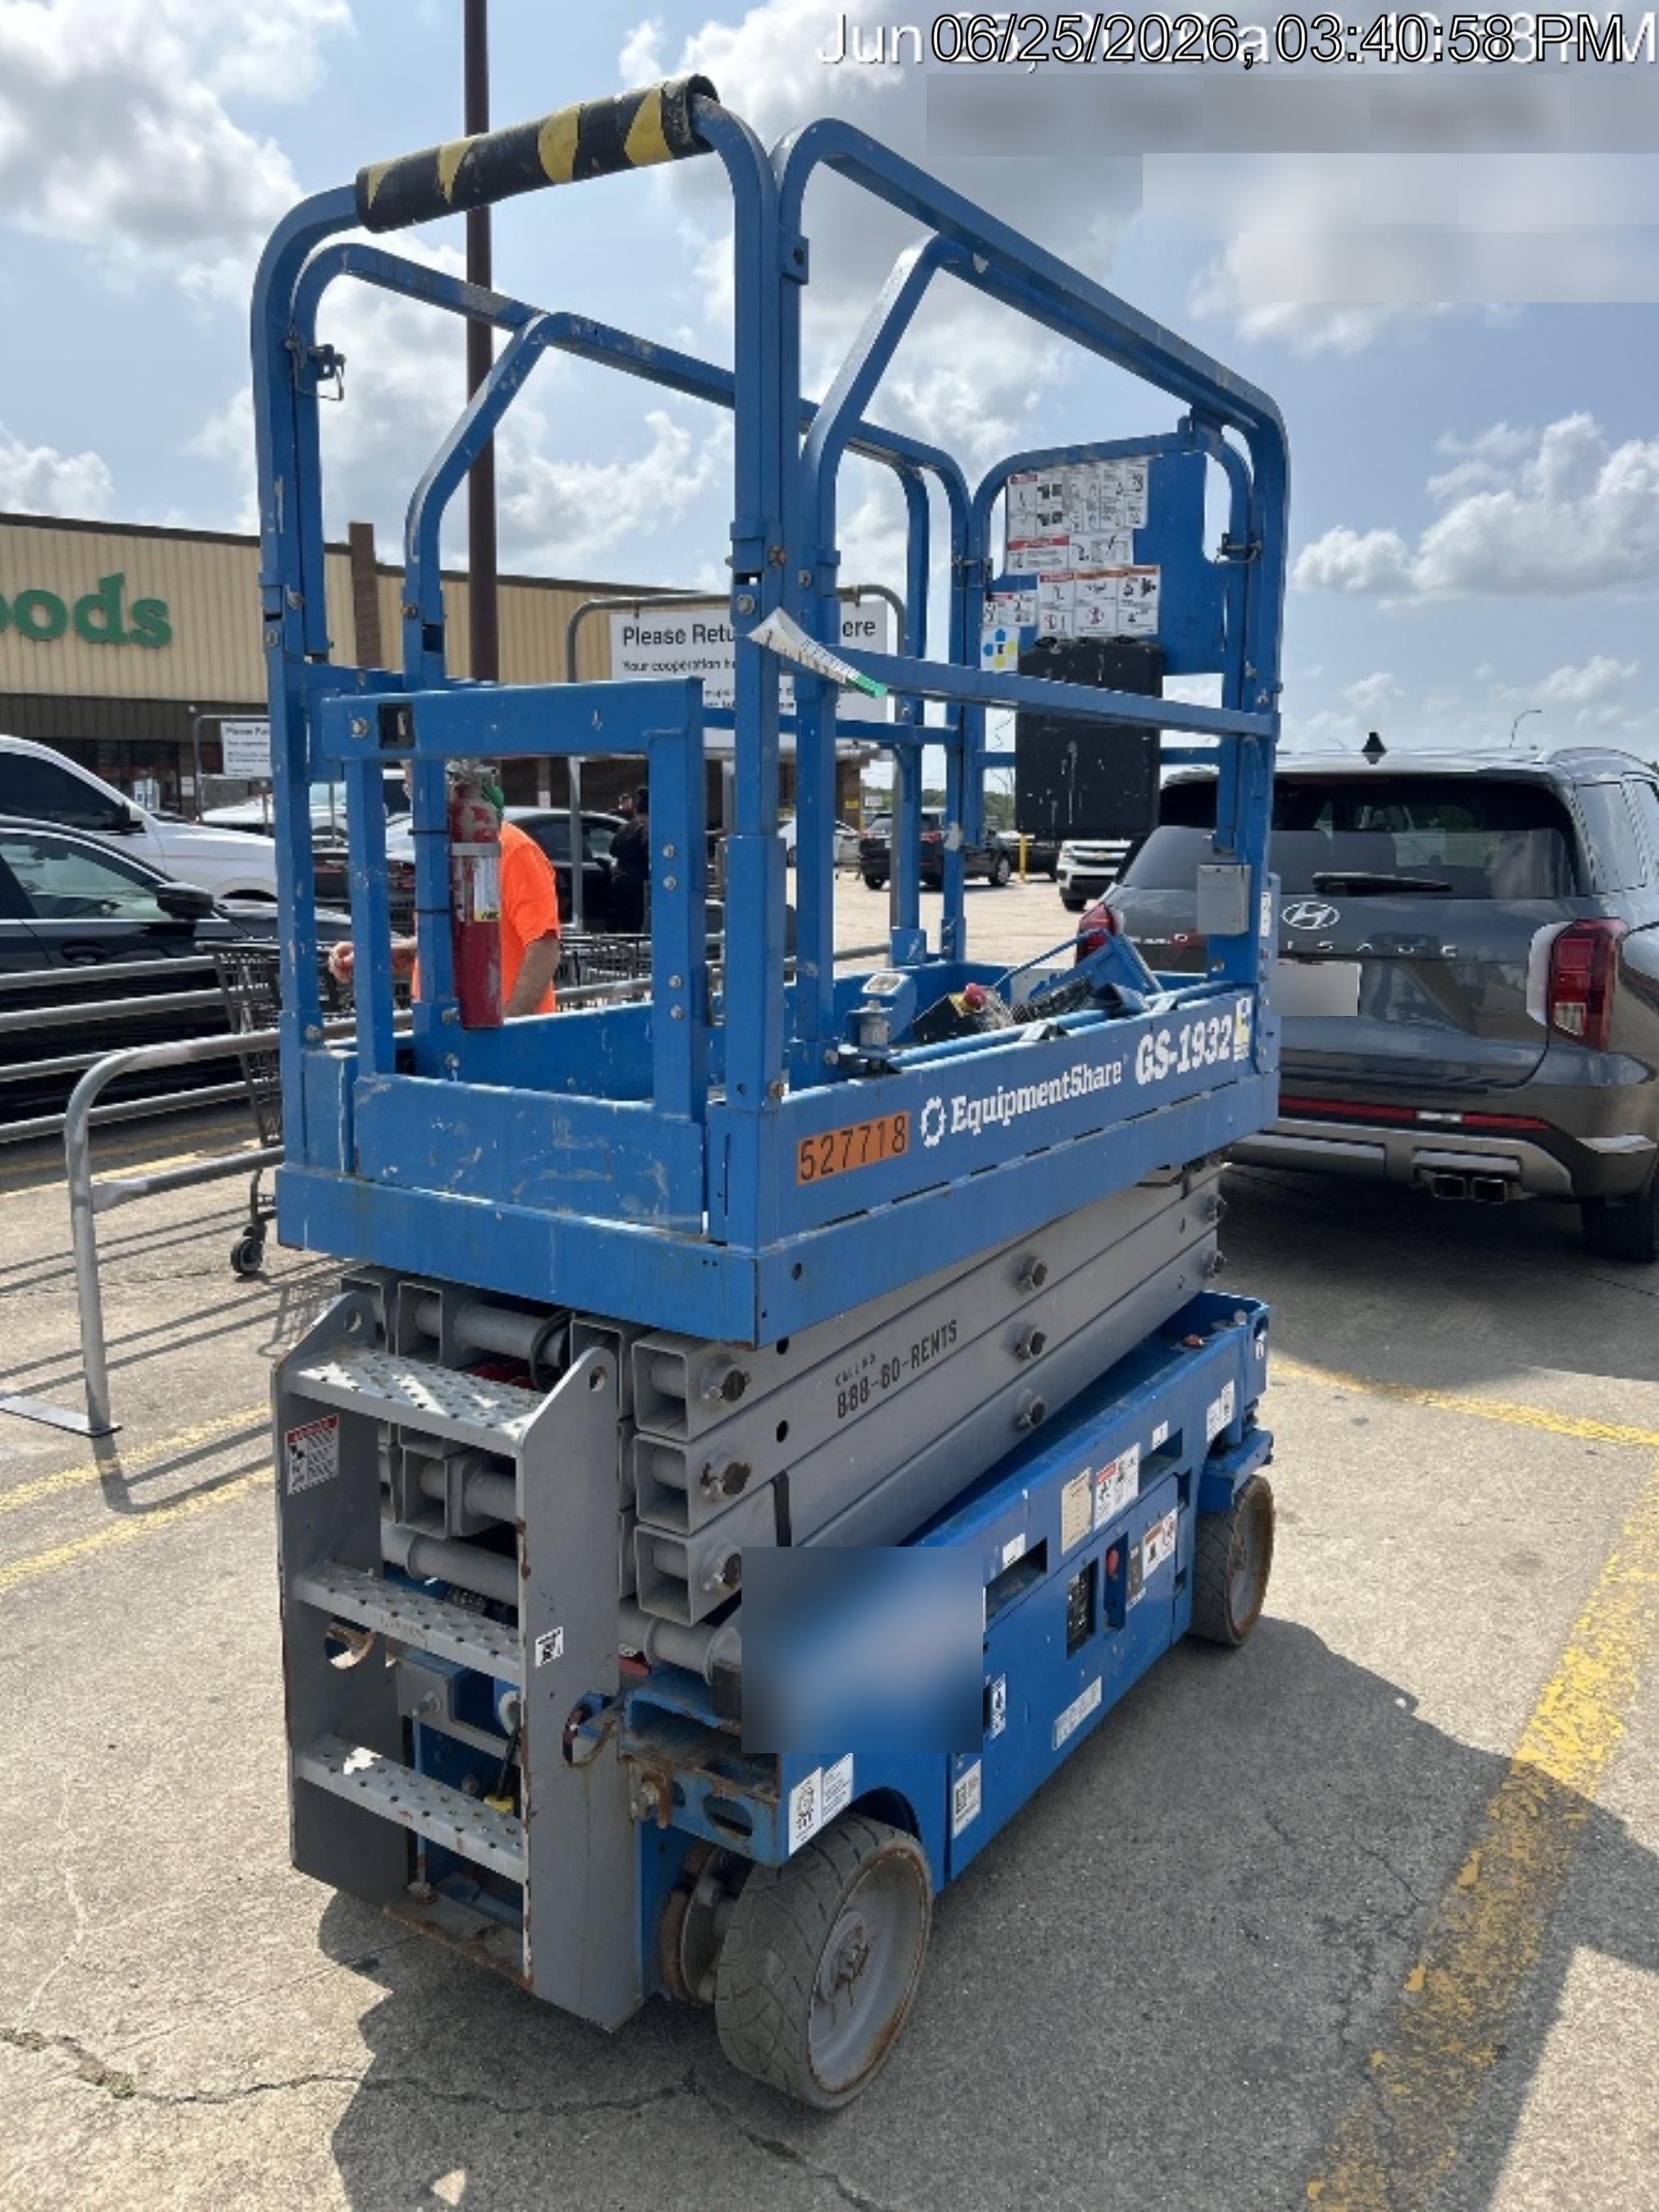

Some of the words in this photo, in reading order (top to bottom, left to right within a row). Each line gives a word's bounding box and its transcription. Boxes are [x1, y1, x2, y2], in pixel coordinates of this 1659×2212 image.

[0, 572, 172, 649] ods
[623, 626, 687, 646] Please
[1135, 1014, 1232, 1086] GS-1932
[950, 1061, 1122, 1136] EquipmentShare
[800, 1115, 905, 1180] 527718
